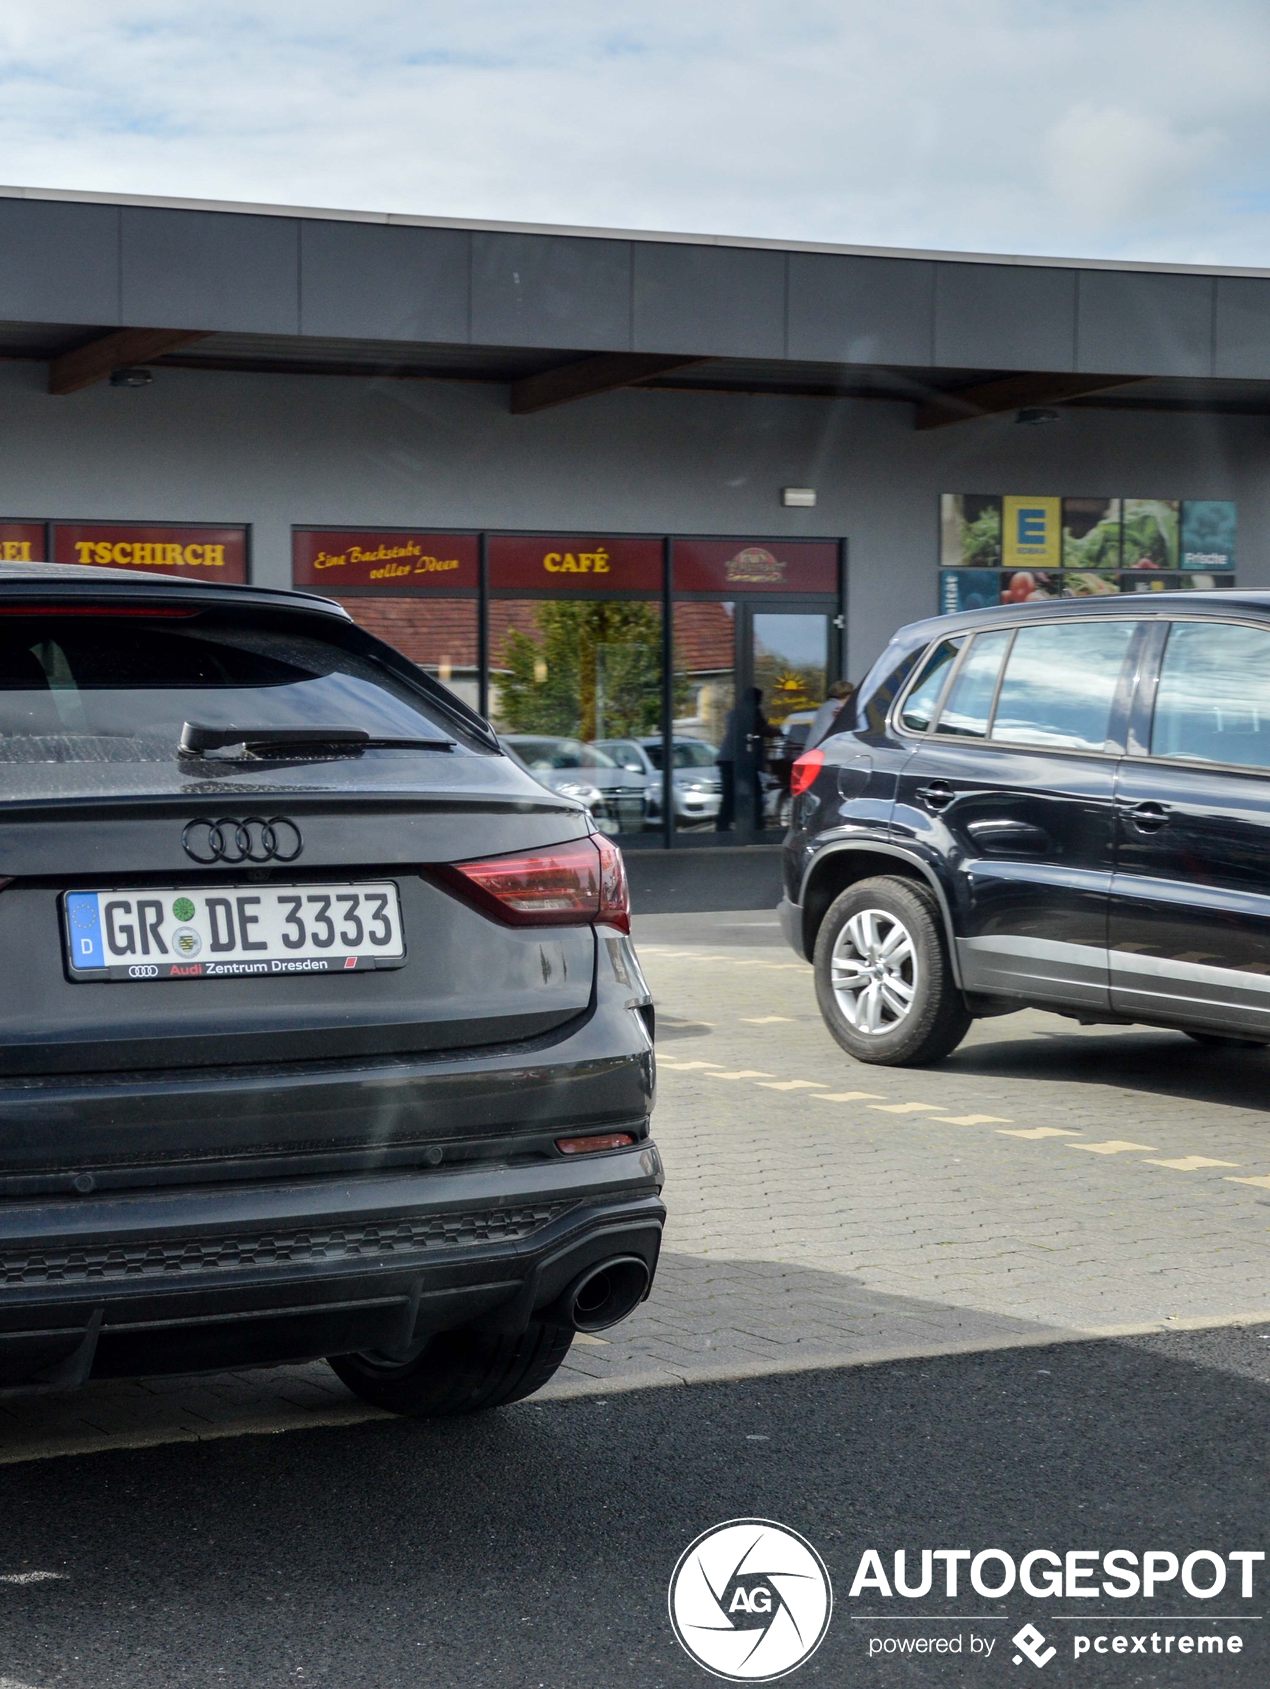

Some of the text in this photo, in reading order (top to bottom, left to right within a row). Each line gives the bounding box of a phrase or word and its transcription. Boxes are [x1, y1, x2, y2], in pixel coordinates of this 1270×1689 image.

[1018, 509, 1046, 544] E
[75, 541, 225, 566] TSCHIRCH
[314, 541, 421, 569] Eine Backstube
[543, 547, 610, 572] CAFÉ
[1184, 552, 1228, 564] Frische
[370, 556, 459, 579] voller Ideen
[104, 900, 169, 956] GR
[205, 896, 268, 951] DE
[277, 893, 392, 949] 3333
[81, 939, 93, 954] D
[170, 959, 328, 976] Audi Zentrum Dresden
